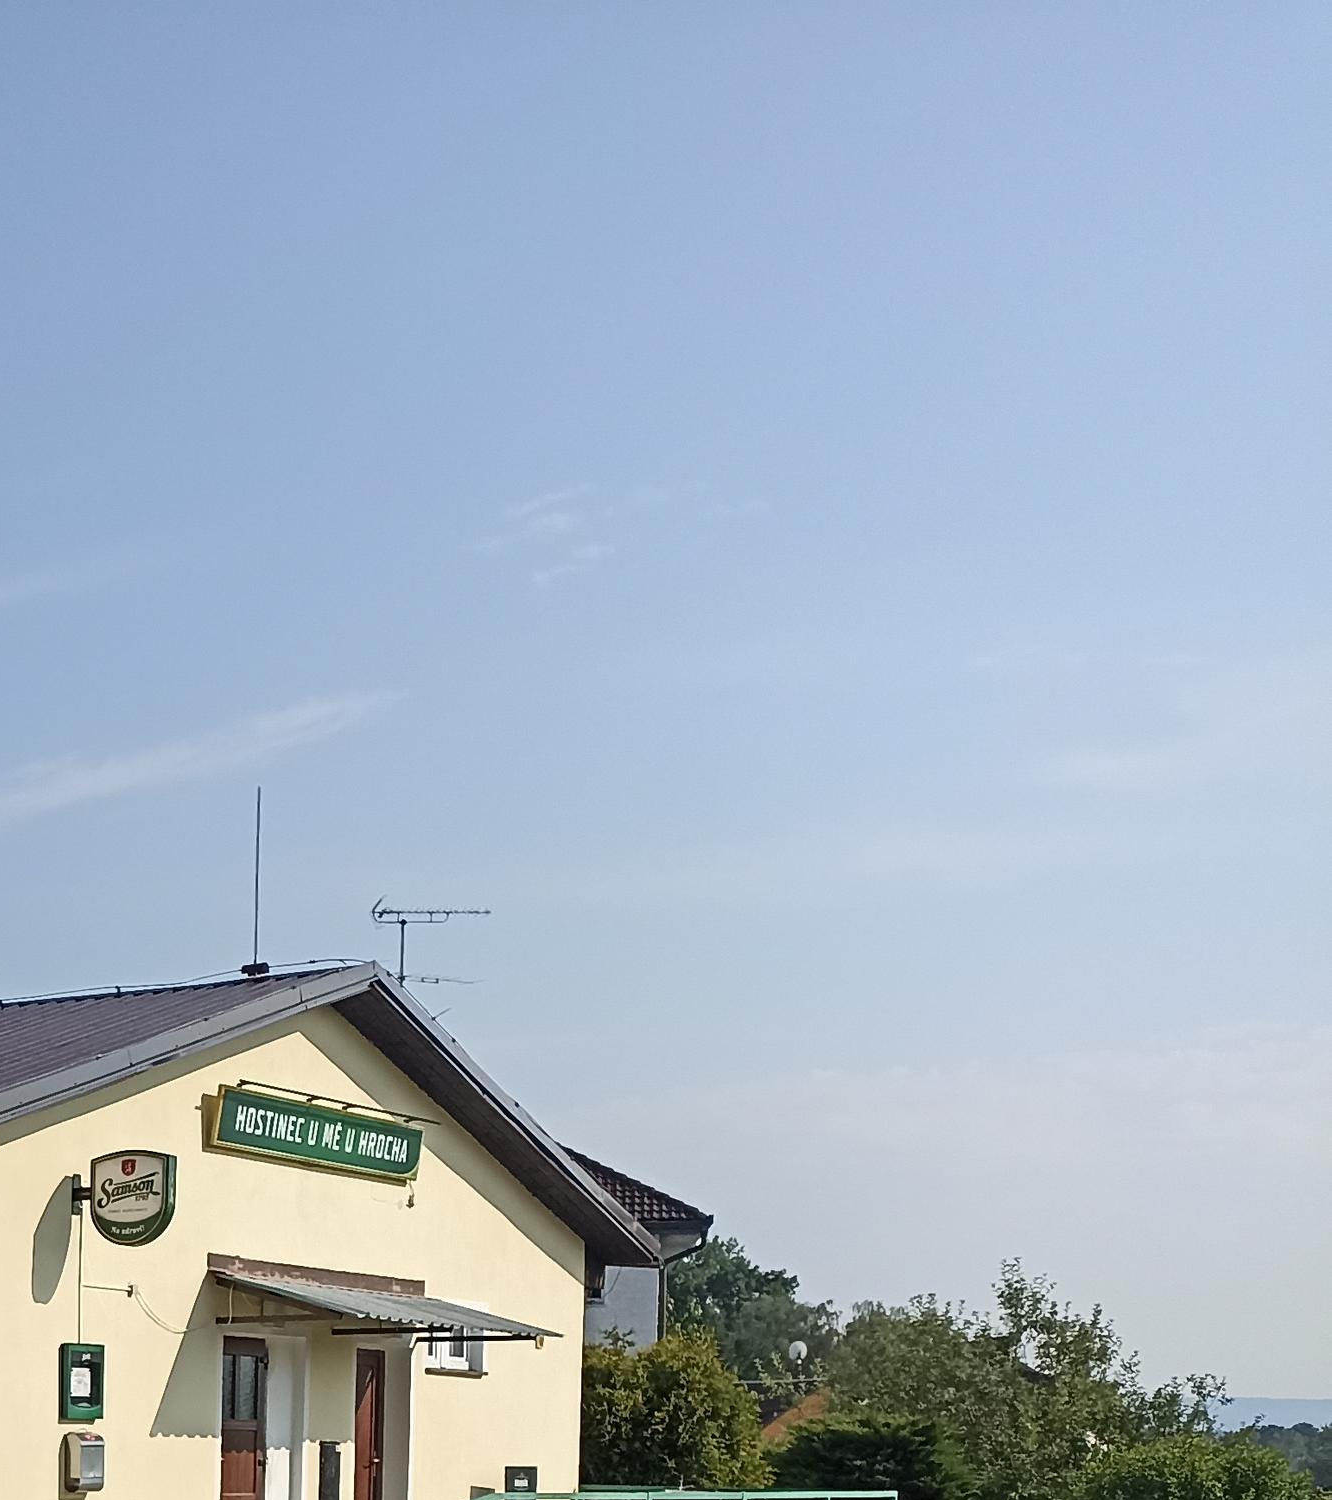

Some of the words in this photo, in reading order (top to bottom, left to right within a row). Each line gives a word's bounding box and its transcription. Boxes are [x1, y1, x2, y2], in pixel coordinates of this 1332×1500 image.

[235, 1105, 305, 1143] HOSTINEC
[307, 1120, 319, 1146] U
[345, 1128, 355, 1153] U
[358, 1130, 408, 1163] HROCHA
[97, 1176, 160, 1208] Samson
